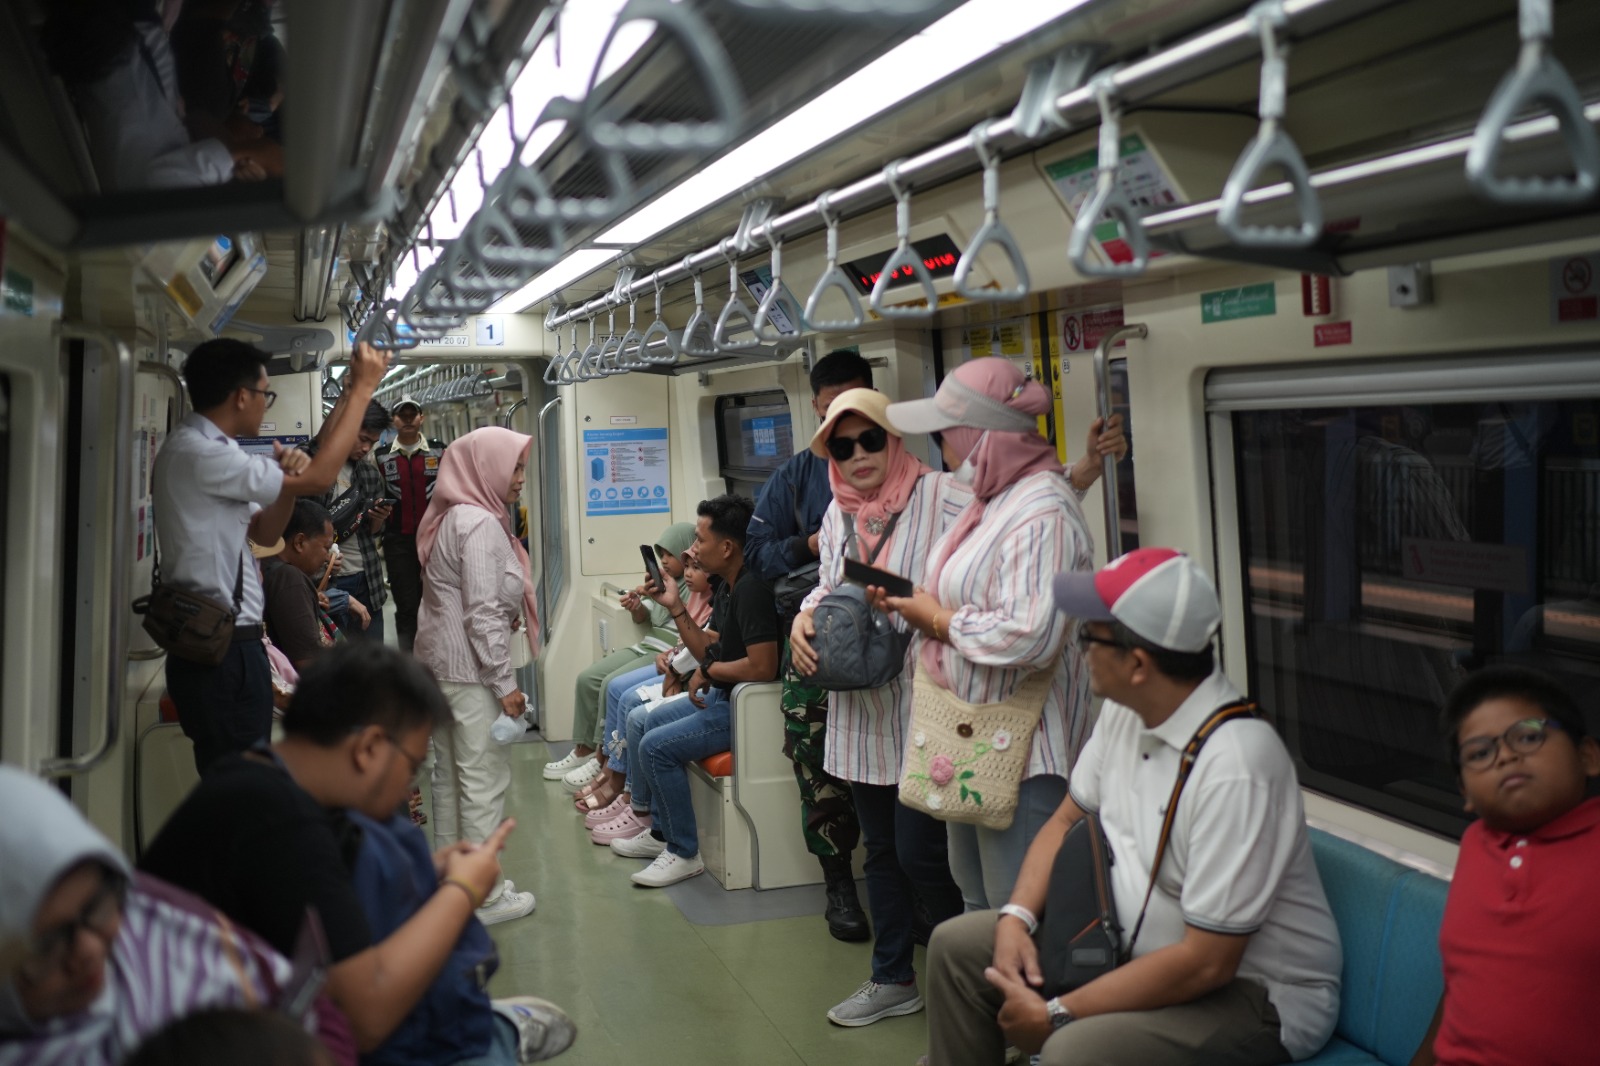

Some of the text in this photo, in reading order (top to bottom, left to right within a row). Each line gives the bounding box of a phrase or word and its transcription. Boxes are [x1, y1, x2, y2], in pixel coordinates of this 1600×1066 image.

[485, 324, 494, 340] 1
[444, 336, 454, 345] 20
[456, 336, 467, 345] 07
